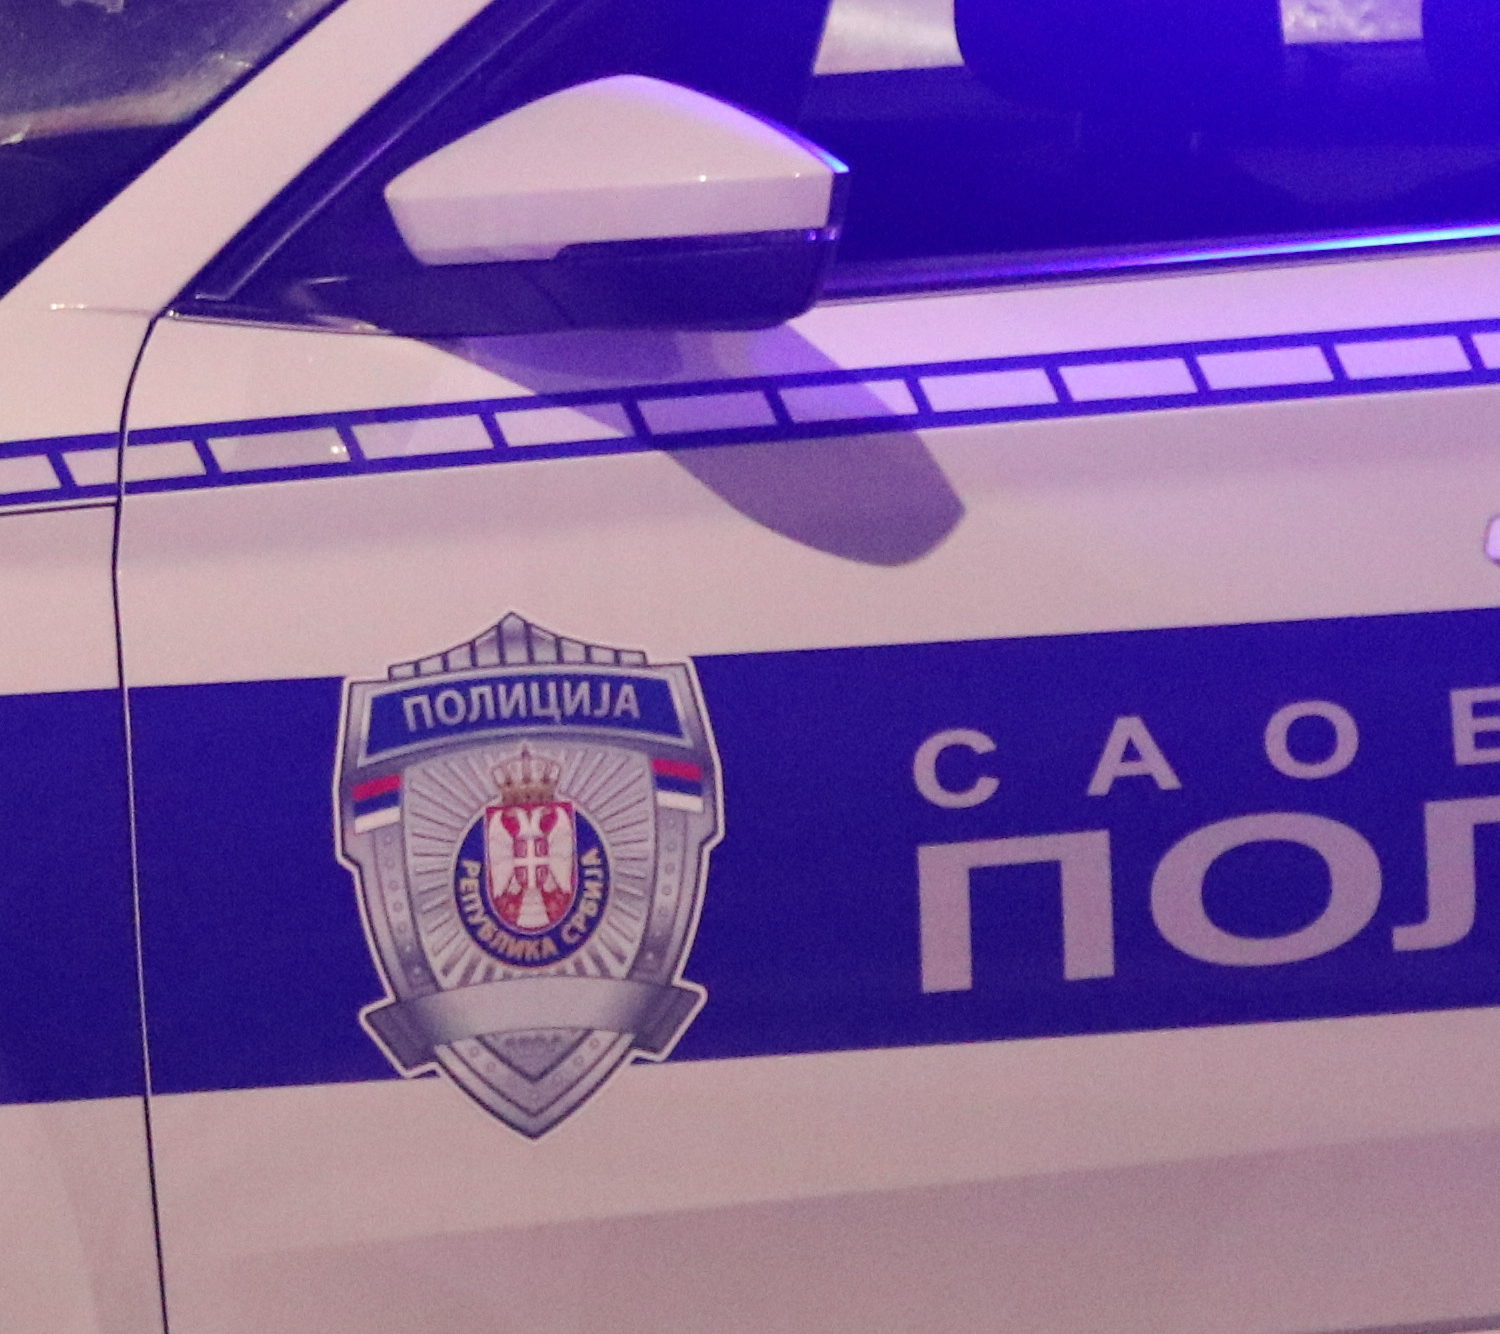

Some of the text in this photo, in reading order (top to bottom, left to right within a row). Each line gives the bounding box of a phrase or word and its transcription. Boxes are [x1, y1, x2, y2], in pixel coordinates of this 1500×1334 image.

[403, 681, 641, 732] ПОЛИЦИЈА
[459, 846, 604, 962] РЕПУБЛИКА СРБИЈА
